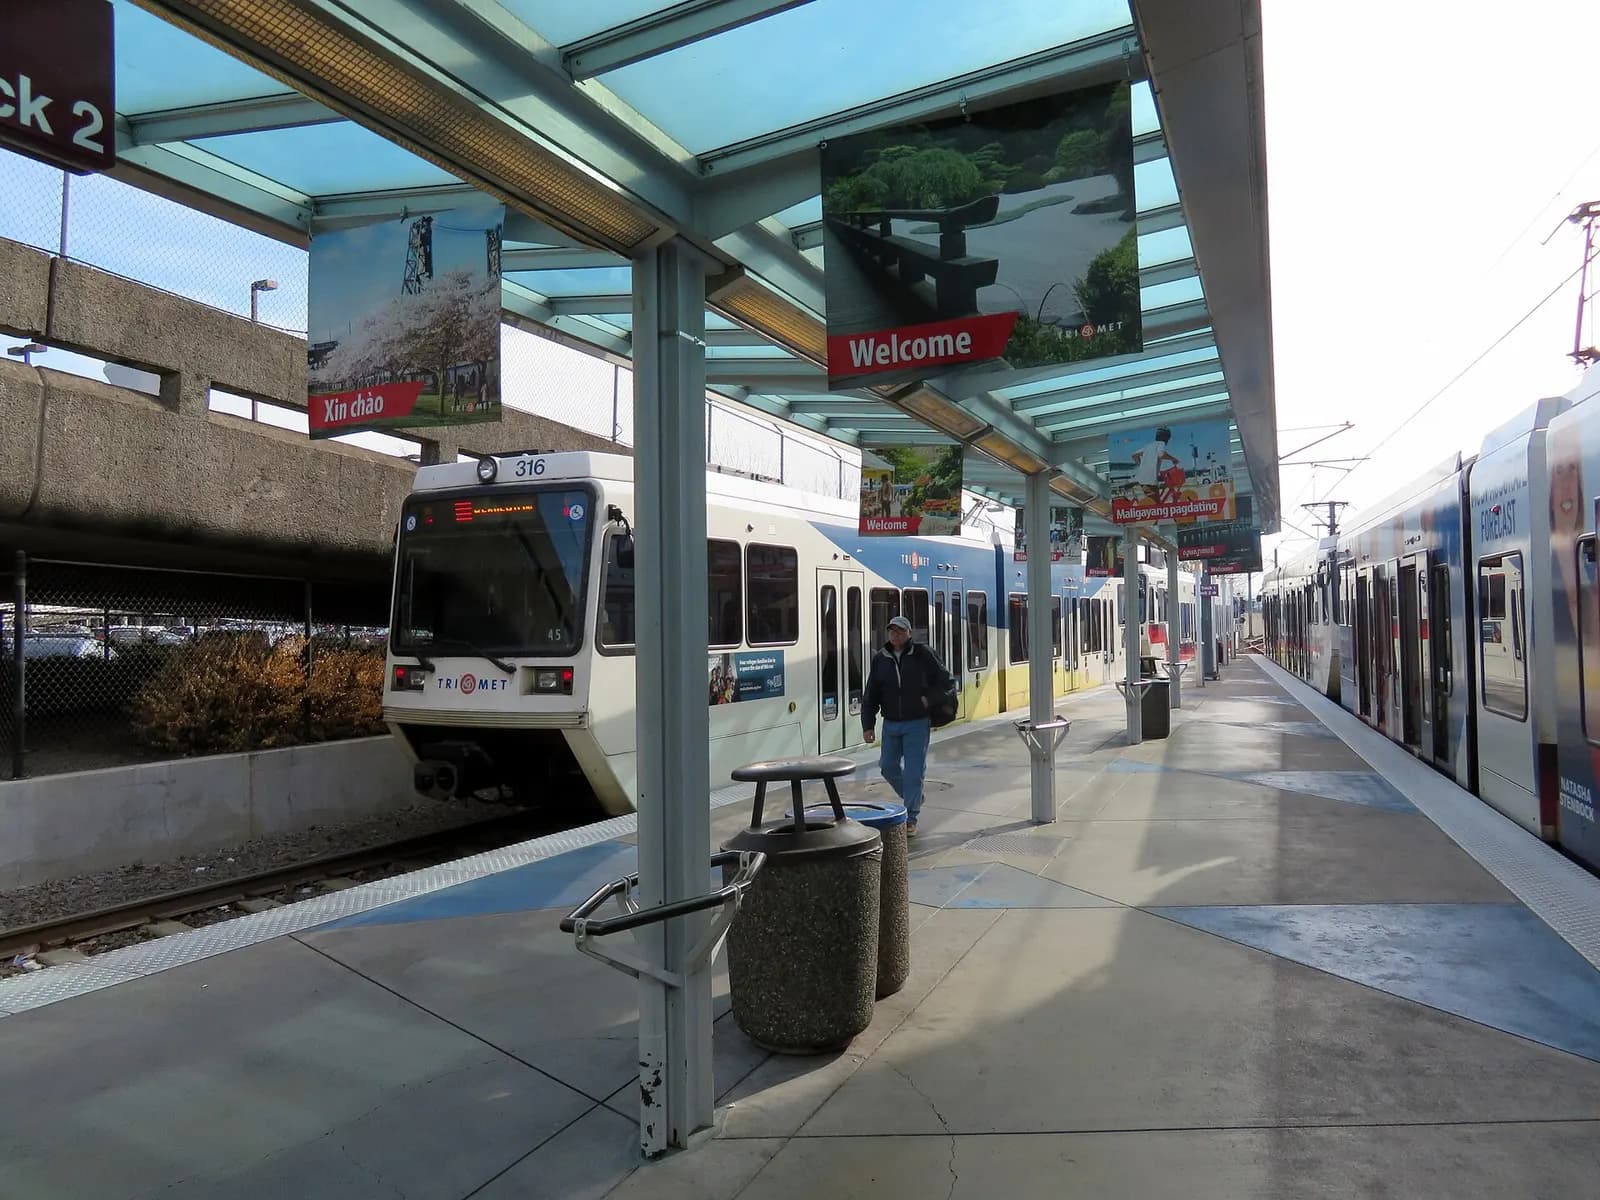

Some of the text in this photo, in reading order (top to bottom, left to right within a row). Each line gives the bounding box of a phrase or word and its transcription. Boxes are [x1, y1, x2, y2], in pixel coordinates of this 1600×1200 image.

[72, 100, 104, 154] 2
[849, 331, 972, 368] Welcome
[324, 392, 384, 422] Xin chào
[515, 458, 545, 477] 316
[1116, 501, 1218, 520] Maligayang pagdating
[866, 519, 908, 531] Welcome
[437, 678, 508, 690] TRI MET
[1560, 775, 1592, 804] NATASHA
